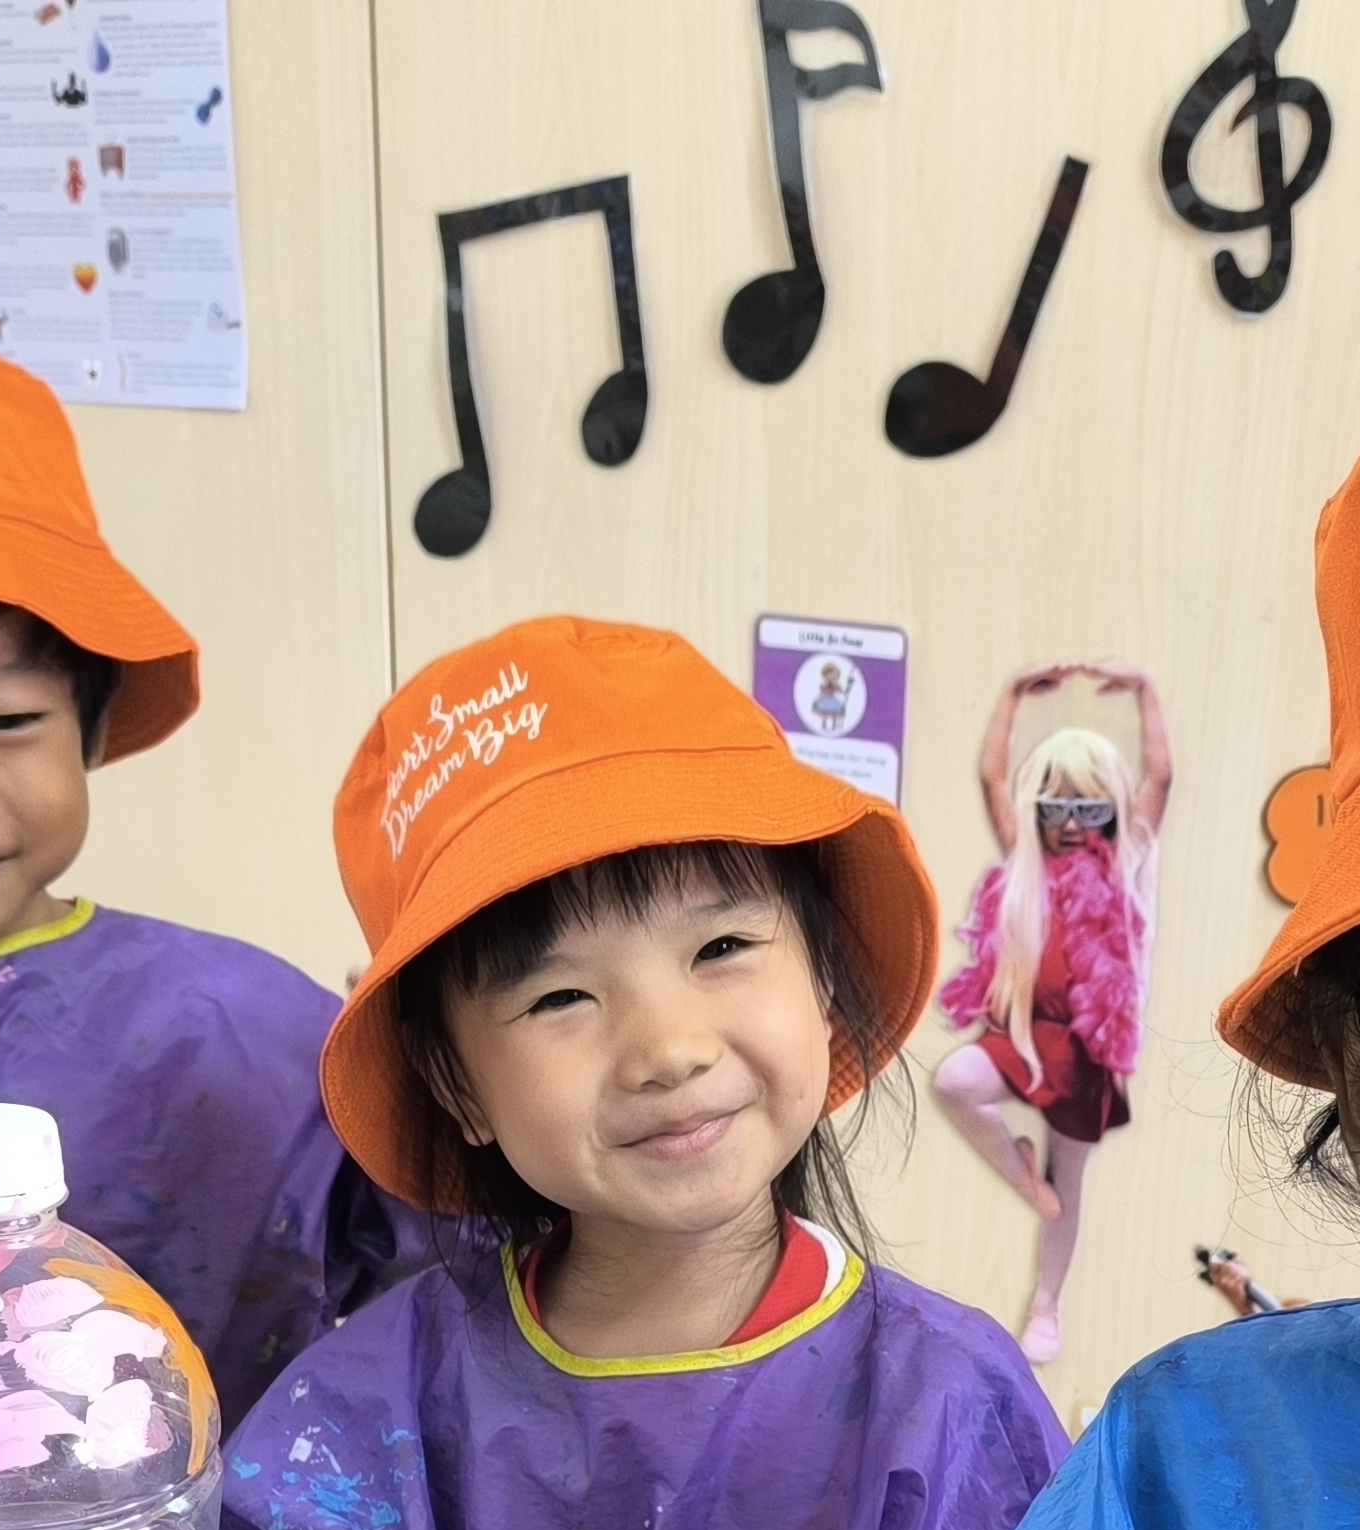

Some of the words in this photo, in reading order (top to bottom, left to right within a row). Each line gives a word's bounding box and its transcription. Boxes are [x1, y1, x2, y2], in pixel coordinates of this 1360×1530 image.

[427, 661, 528, 751] Small
[385, 748, 469, 862] Dream
[464, 702, 548, 766] Big
